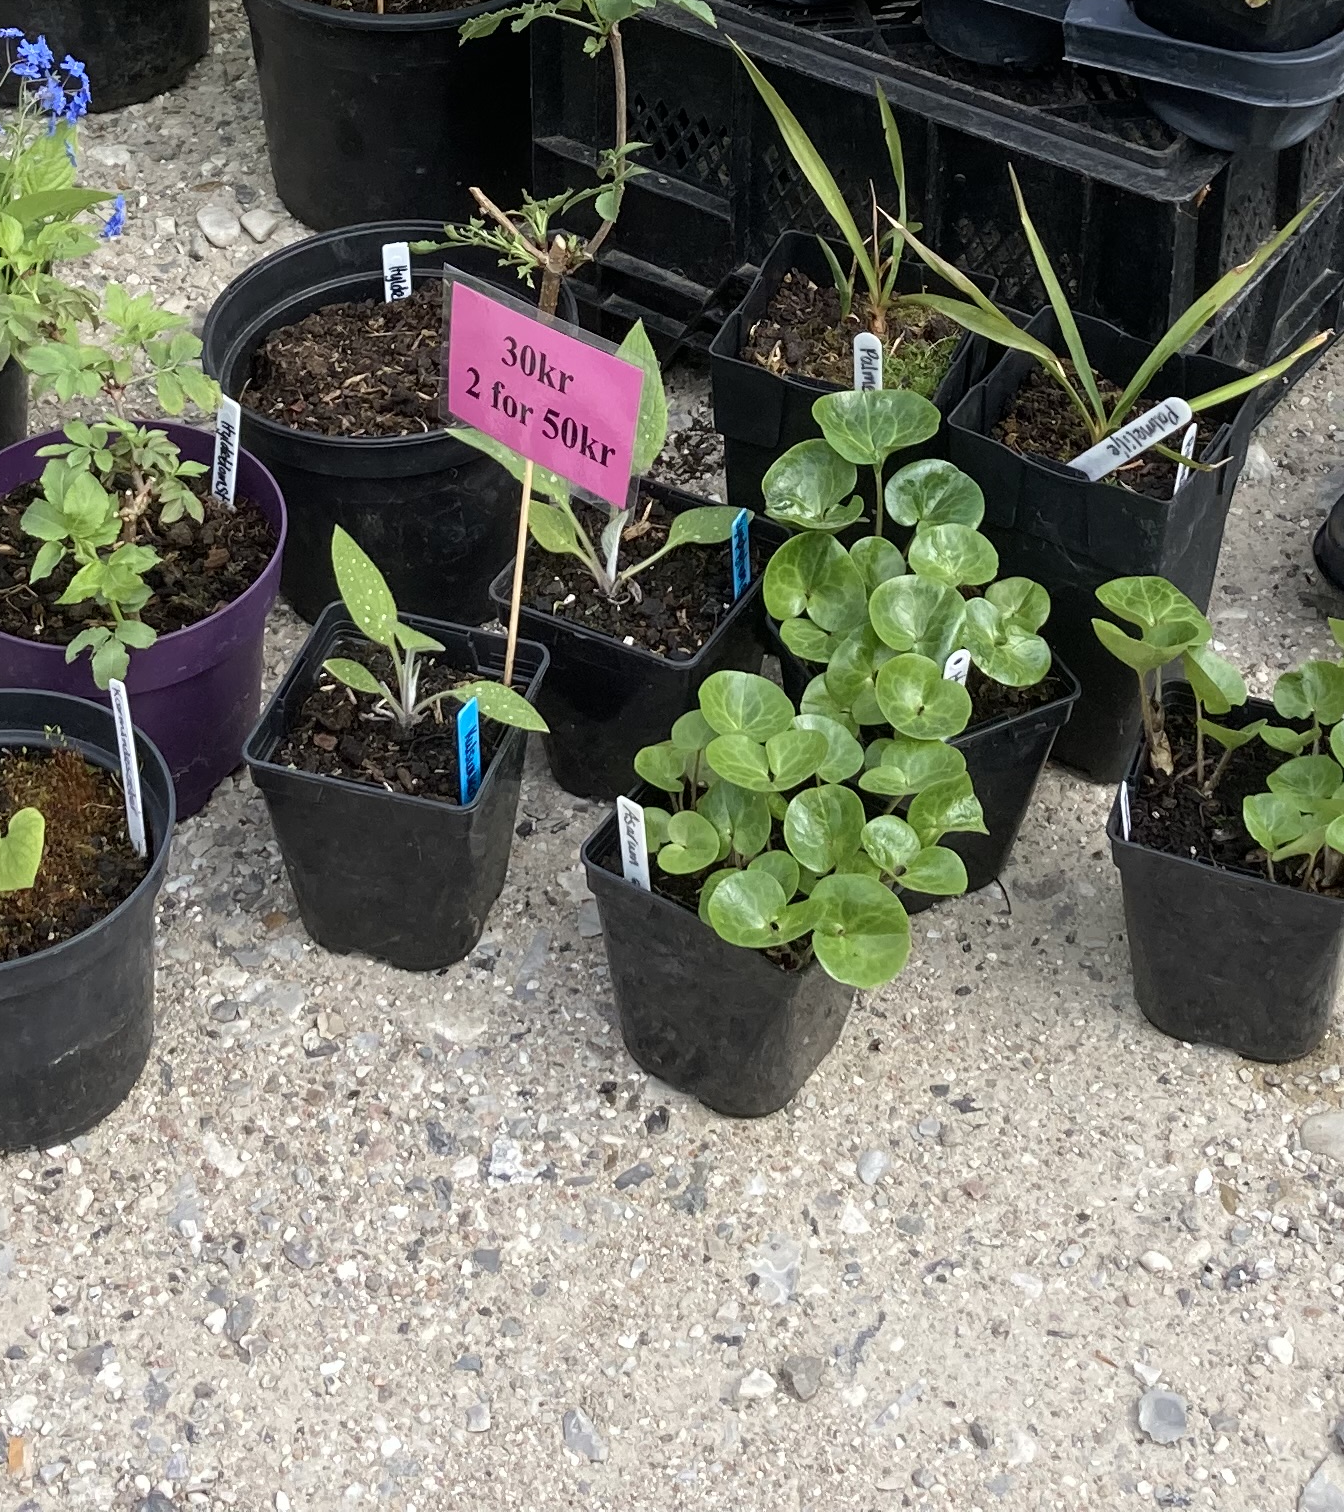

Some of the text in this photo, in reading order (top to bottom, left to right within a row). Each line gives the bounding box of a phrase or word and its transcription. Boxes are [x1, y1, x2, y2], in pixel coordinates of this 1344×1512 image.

[501, 336, 576, 396] 30kr
[465, 367, 617, 469] 2 for 50kr
[1107, 406, 1178, 457] Palmelilje
[623, 802, 639, 866] Asarum
